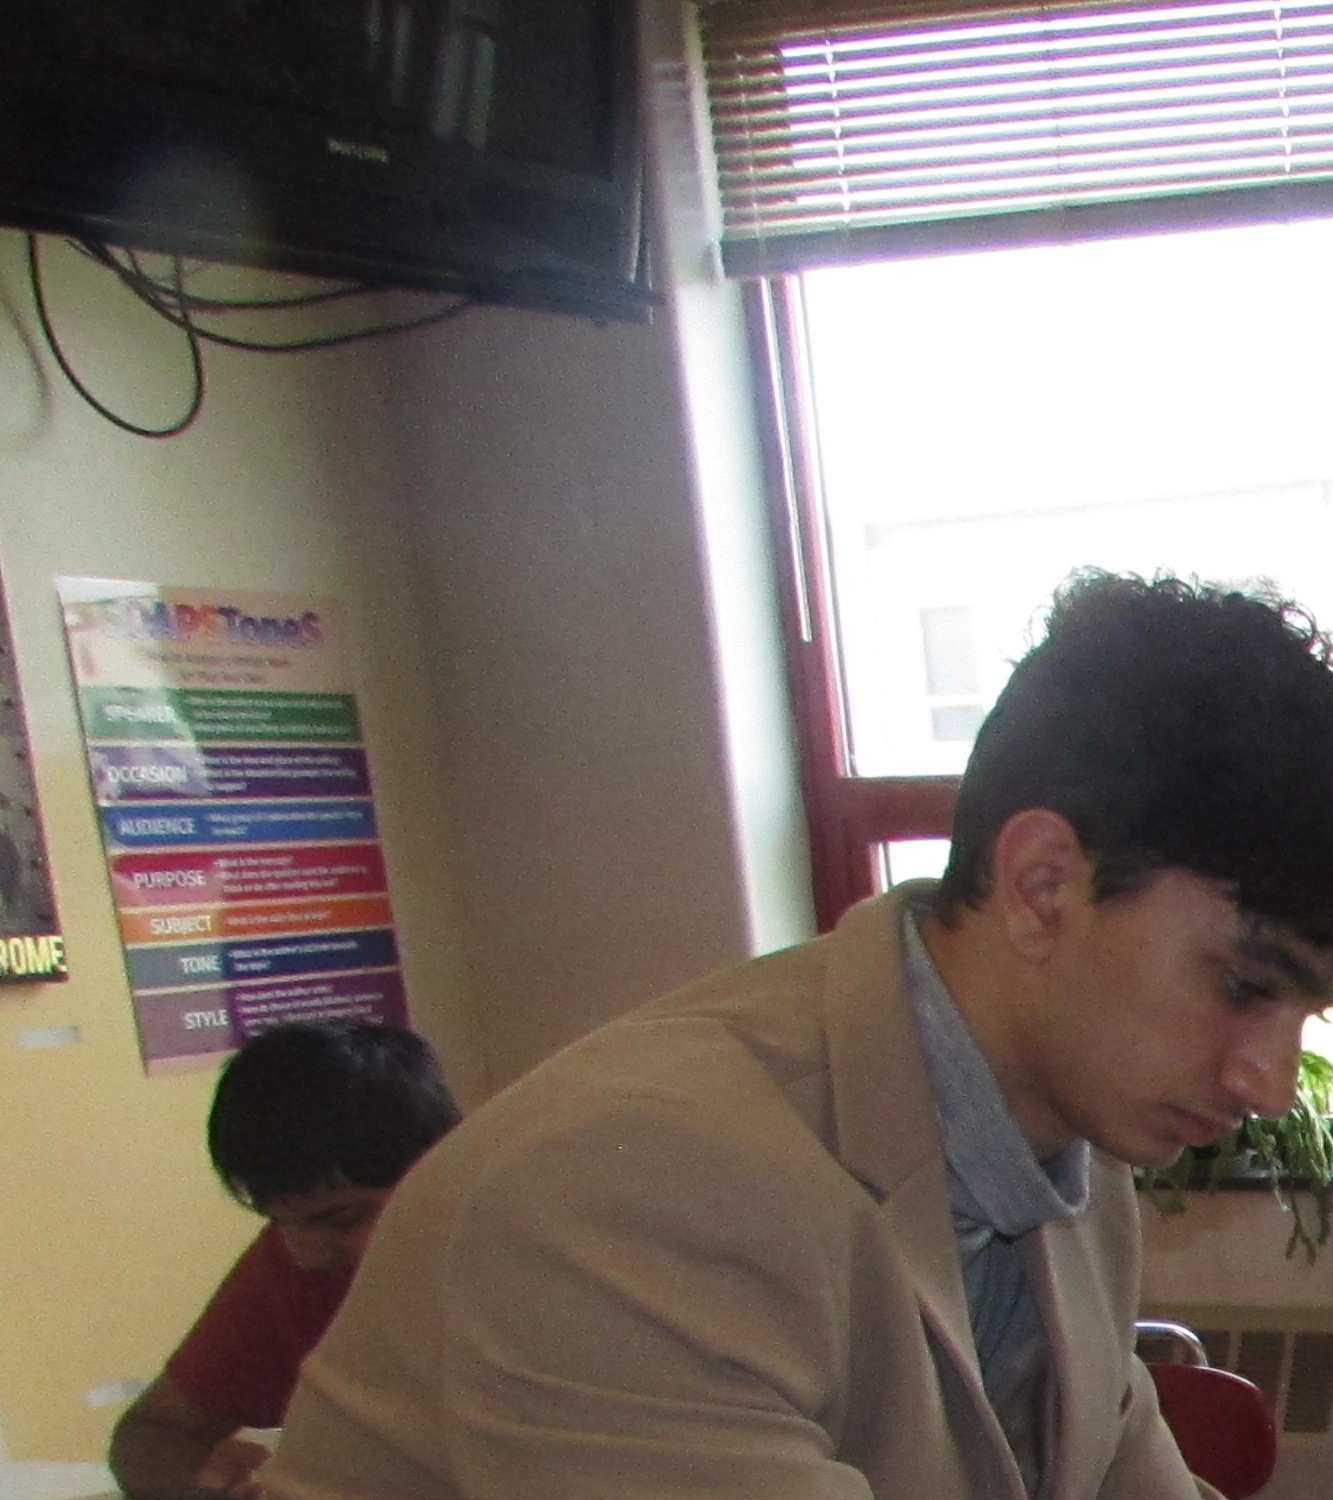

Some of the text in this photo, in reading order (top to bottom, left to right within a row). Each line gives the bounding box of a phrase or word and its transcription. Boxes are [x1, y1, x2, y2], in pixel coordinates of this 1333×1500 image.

[107, 765, 188, 783] OCCASION
[119, 817, 197, 836] AUDIENCE
[132, 869, 207, 889] PURPOSE
[150, 915, 212, 936] SUBJECT
[180, 954, 221, 975] TONE
[184, 1009, 230, 1030] STYLE
